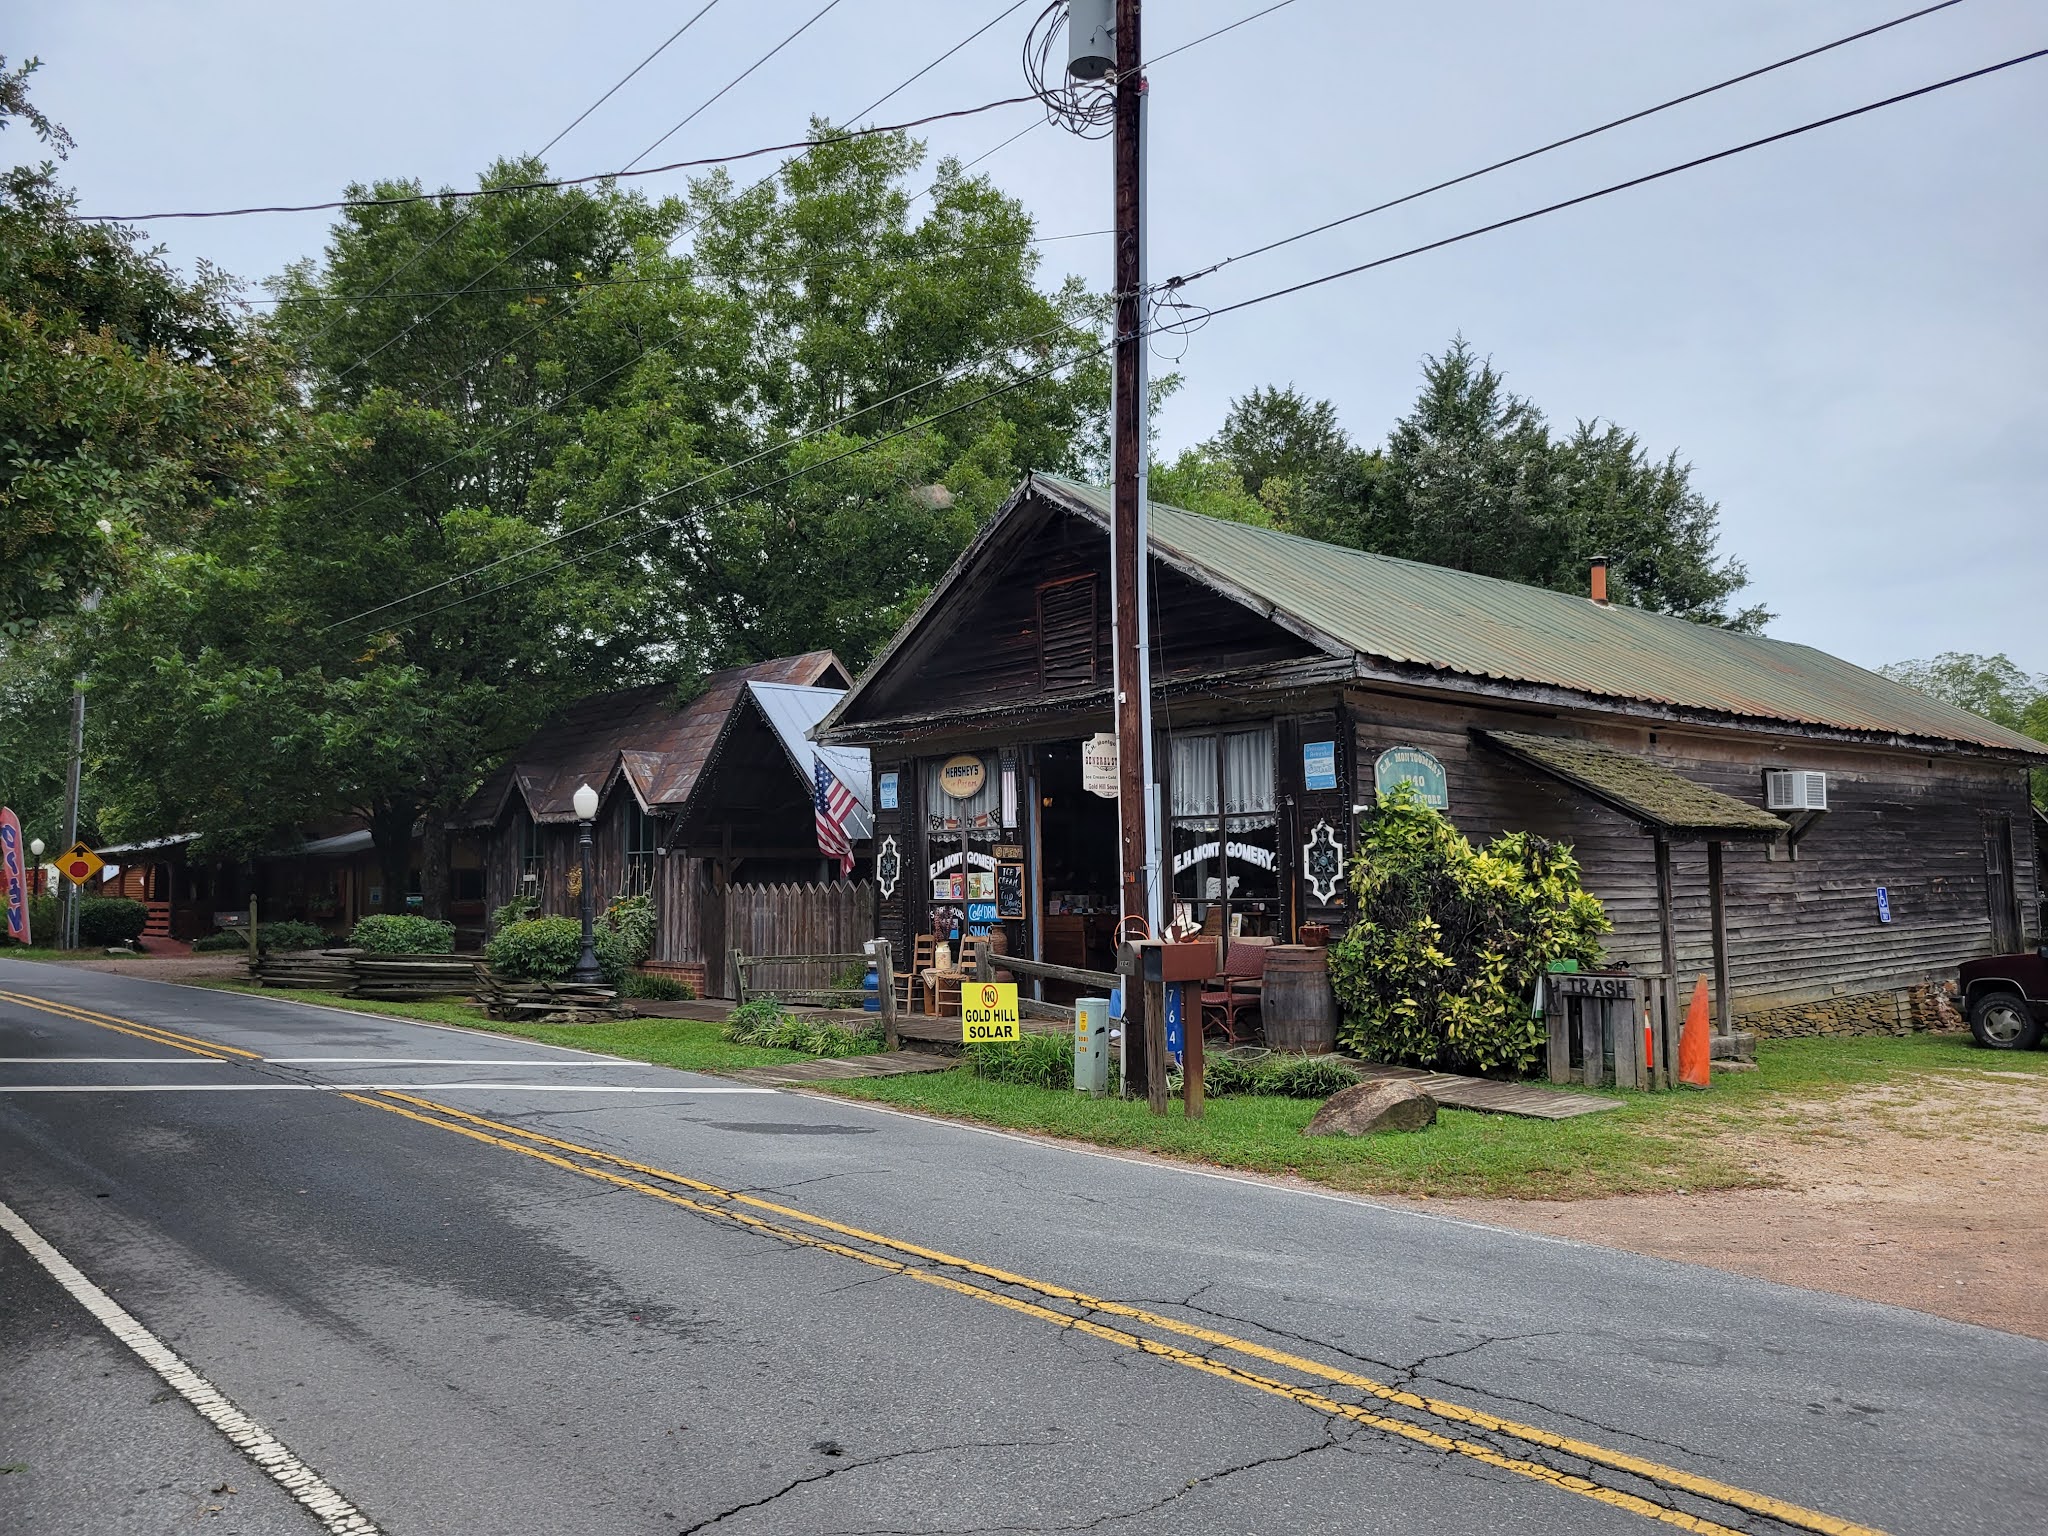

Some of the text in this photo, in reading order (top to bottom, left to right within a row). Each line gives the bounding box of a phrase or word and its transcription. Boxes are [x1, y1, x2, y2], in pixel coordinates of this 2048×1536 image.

[945, 764, 980, 778] HERSHEY'S
[1394, 752, 1442, 777] MONTGOMERY
[1567, 977, 1627, 998] TRASH
[984, 990, 995, 1003] NO
[965, 1009, 1016, 1022] GOLD HILL
[969, 1025, 1013, 1038] SOLAR
